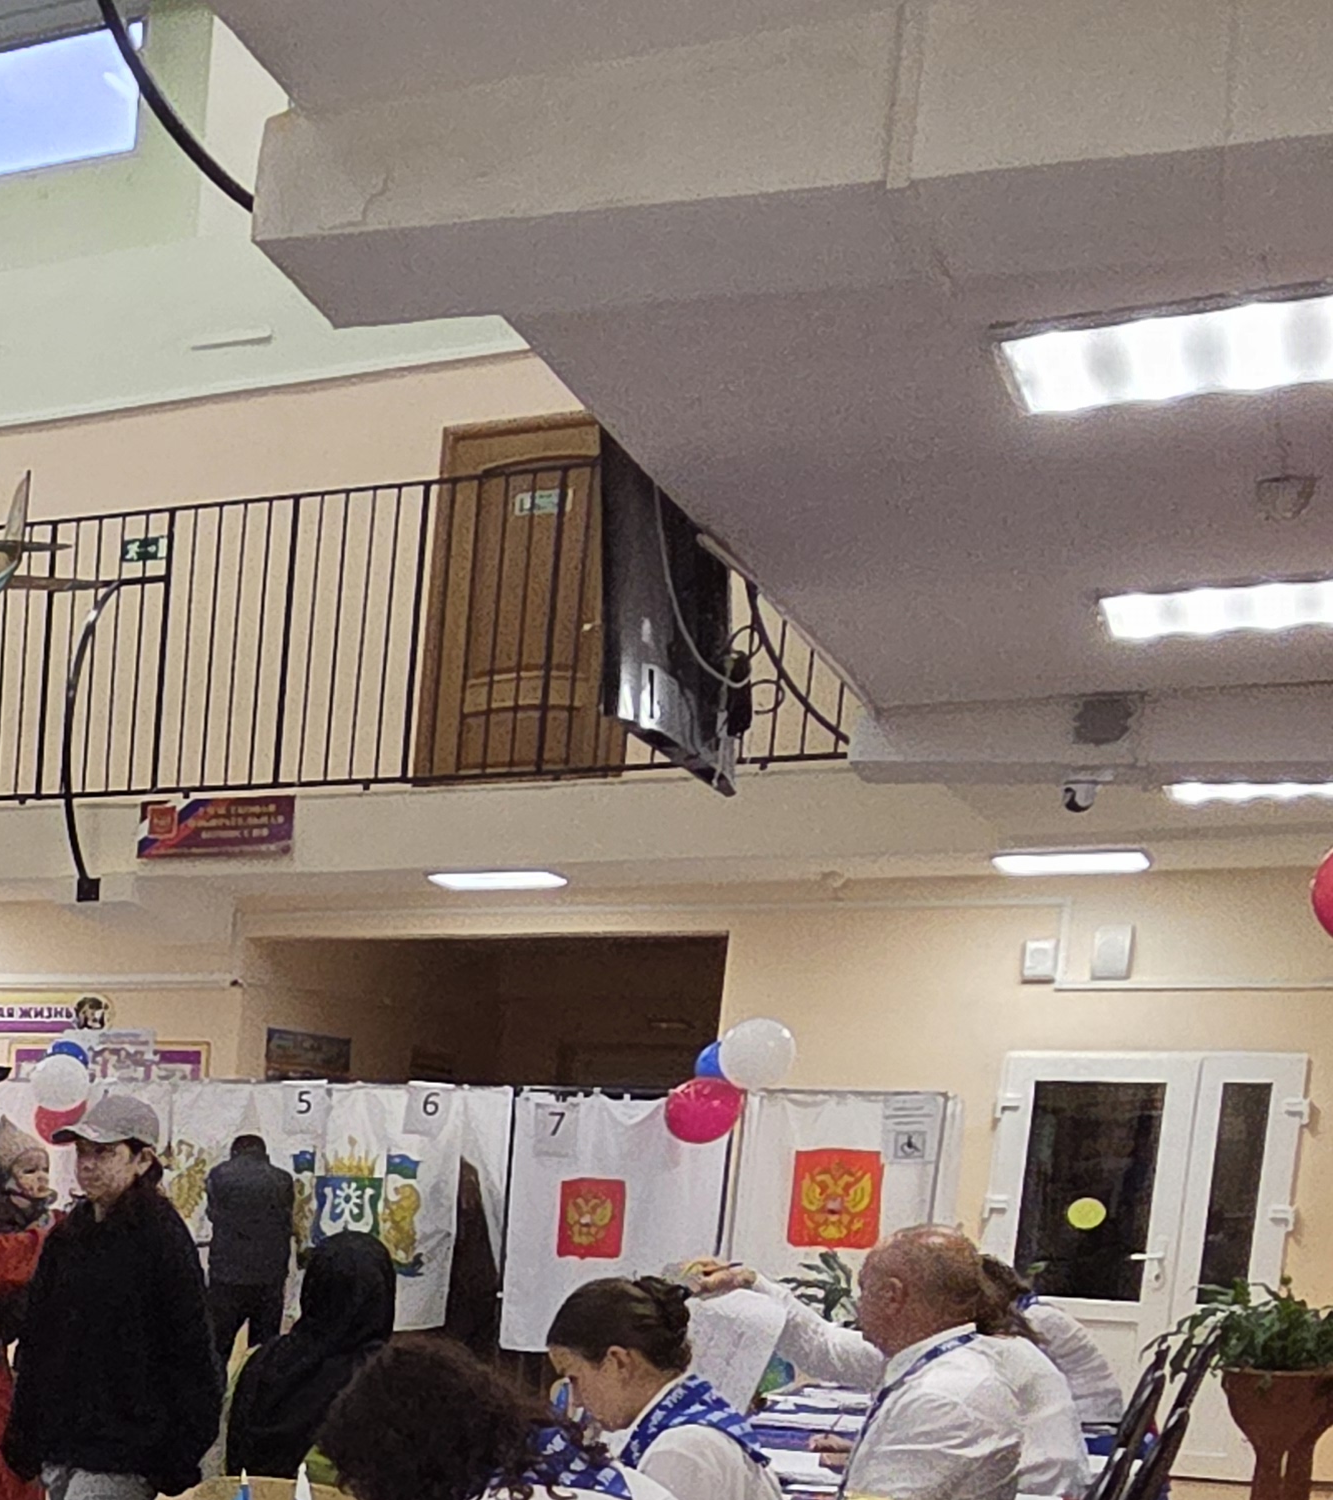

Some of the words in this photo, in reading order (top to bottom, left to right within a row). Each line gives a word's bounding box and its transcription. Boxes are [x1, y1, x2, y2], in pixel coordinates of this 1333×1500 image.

[18, 1006, 74, 1020] ЖИЗНЬ
[295, 1090, 313, 1115] 5
[422, 1092, 441, 1117] 6
[548, 1111, 566, 1137] 7
